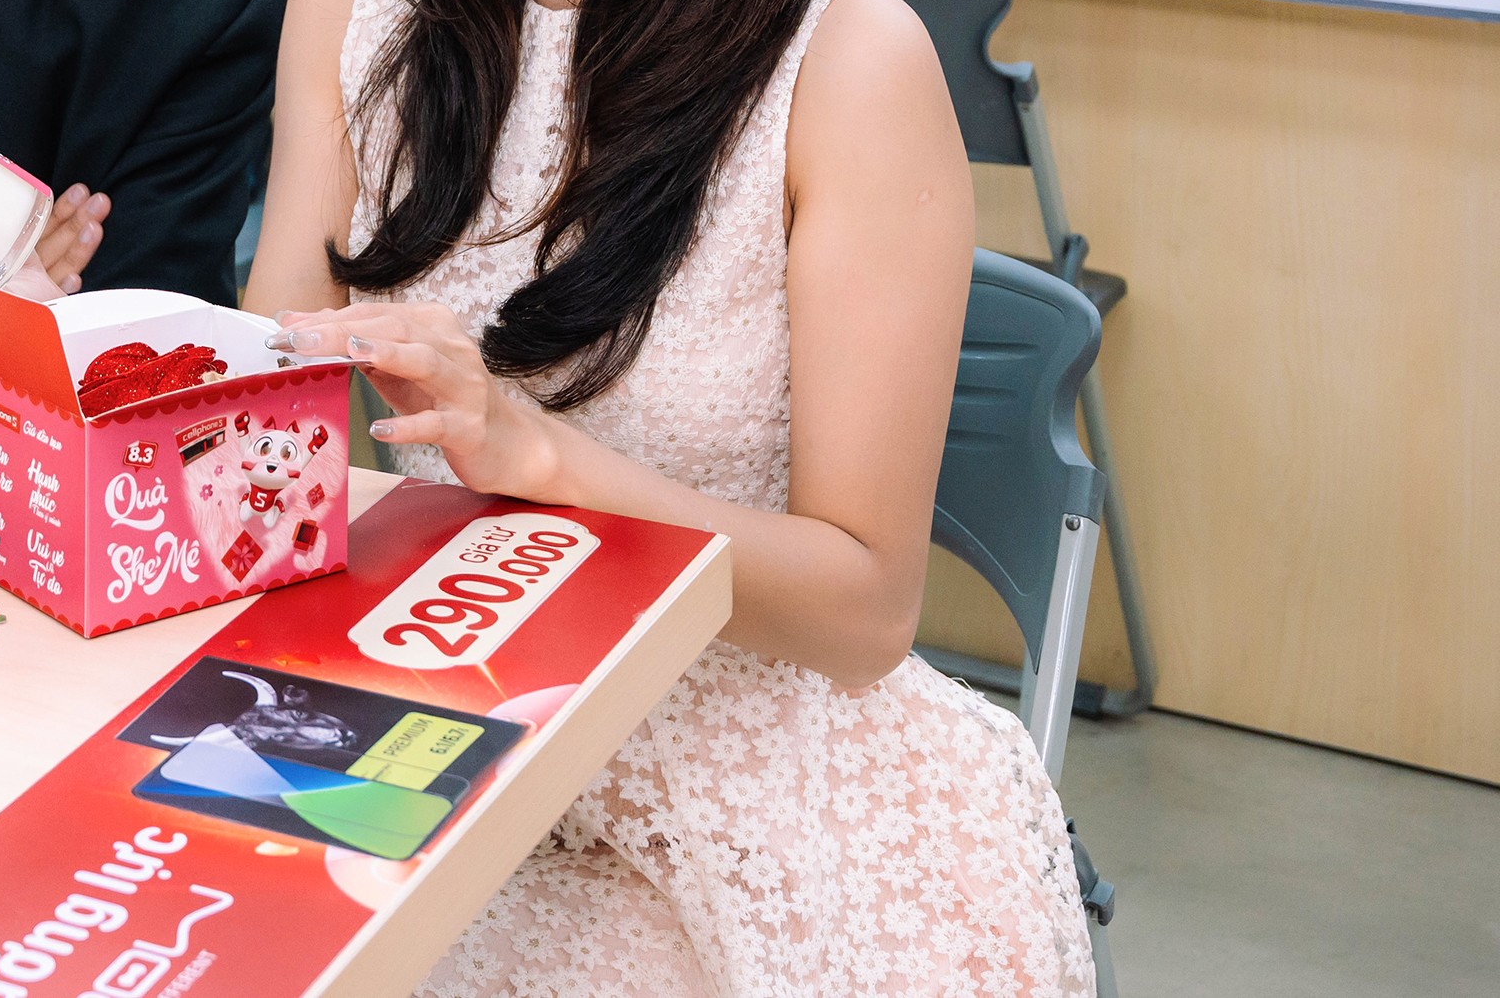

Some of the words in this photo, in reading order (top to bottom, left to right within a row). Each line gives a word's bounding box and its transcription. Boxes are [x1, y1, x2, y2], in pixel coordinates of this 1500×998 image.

[128, 445, 154, 464] 8.3
[27, 458, 60, 492] Hạnh
[29, 489, 56, 513] phúc
[104, 472, 169, 532] Quà
[254, 490, 268, 508] S
[27, 528, 50, 559] Vui
[458, 542, 501, 564] Giá
[483, 525, 517, 547] từ
[47, 576, 62, 595] do
[383, 530, 579, 657] 290.000
[383, 717, 434, 757] PREMIUM
[73, 825, 188, 895] lực
